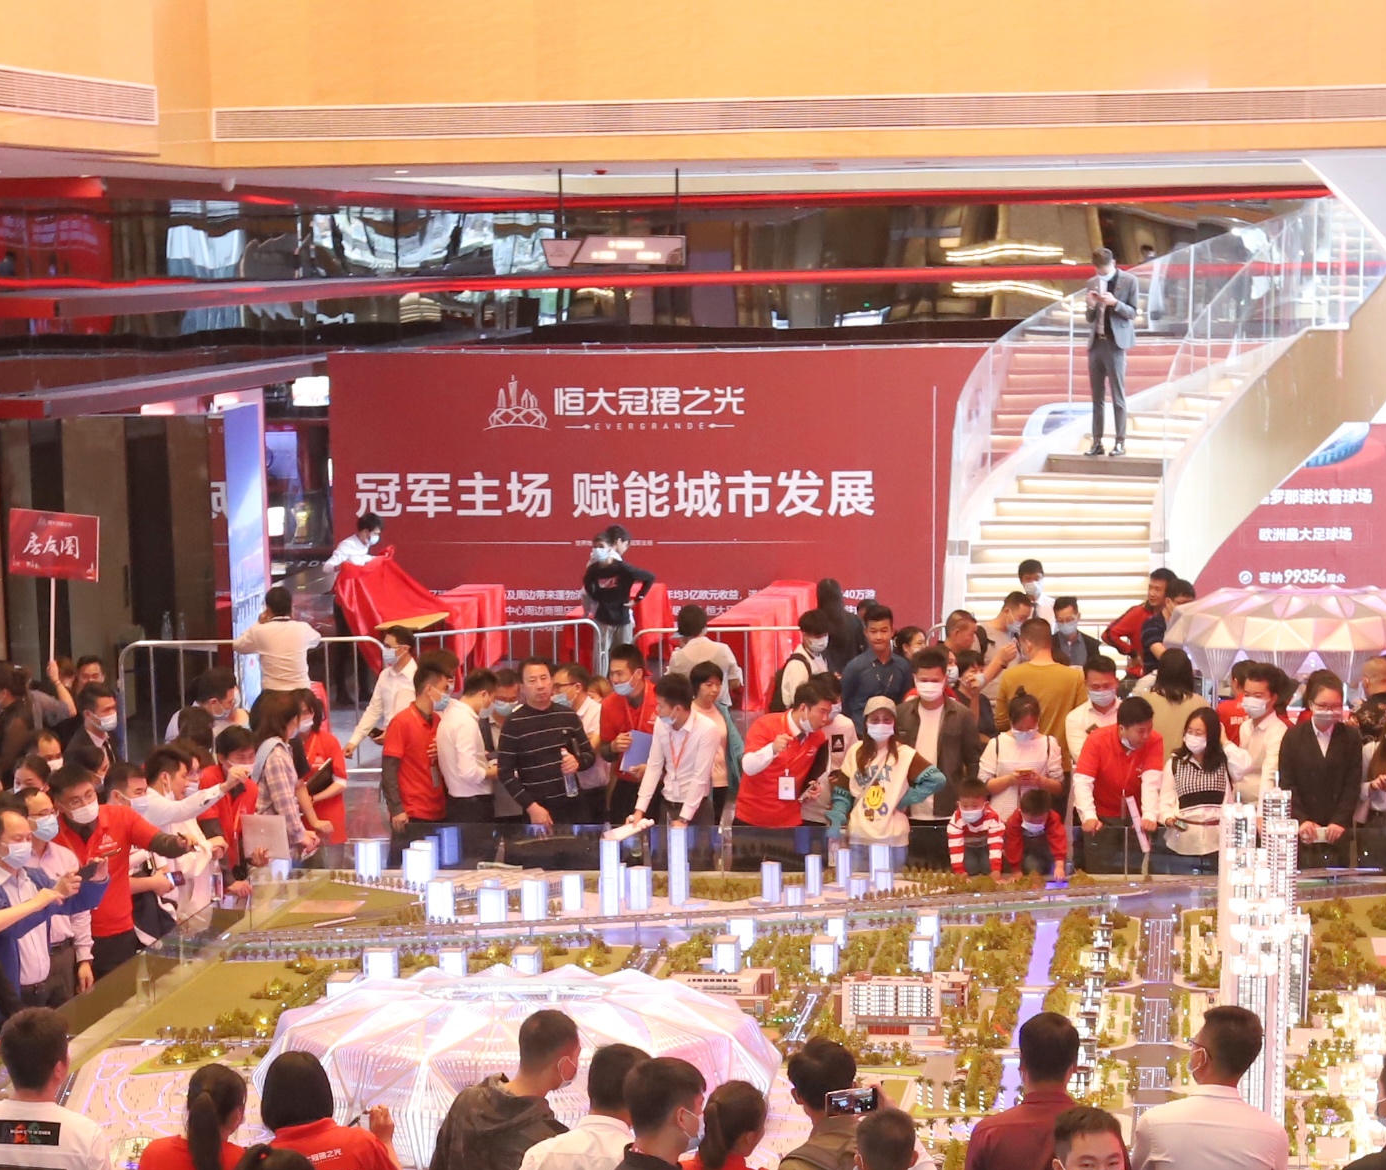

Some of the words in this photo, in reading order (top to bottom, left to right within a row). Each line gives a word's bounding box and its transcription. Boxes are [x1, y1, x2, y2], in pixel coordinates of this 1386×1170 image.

[554, 386, 745, 416] 恒大冠珺之光
[594, 422, 704, 431] EVERGRANDE
[355, 472, 552, 518] 冠军主场
[573, 470, 876, 518] 赋能城市发展
[1259, 527, 1352, 541] 欧洲最大足球场
[1259, 569, 1346, 584] 容纳99354观众
